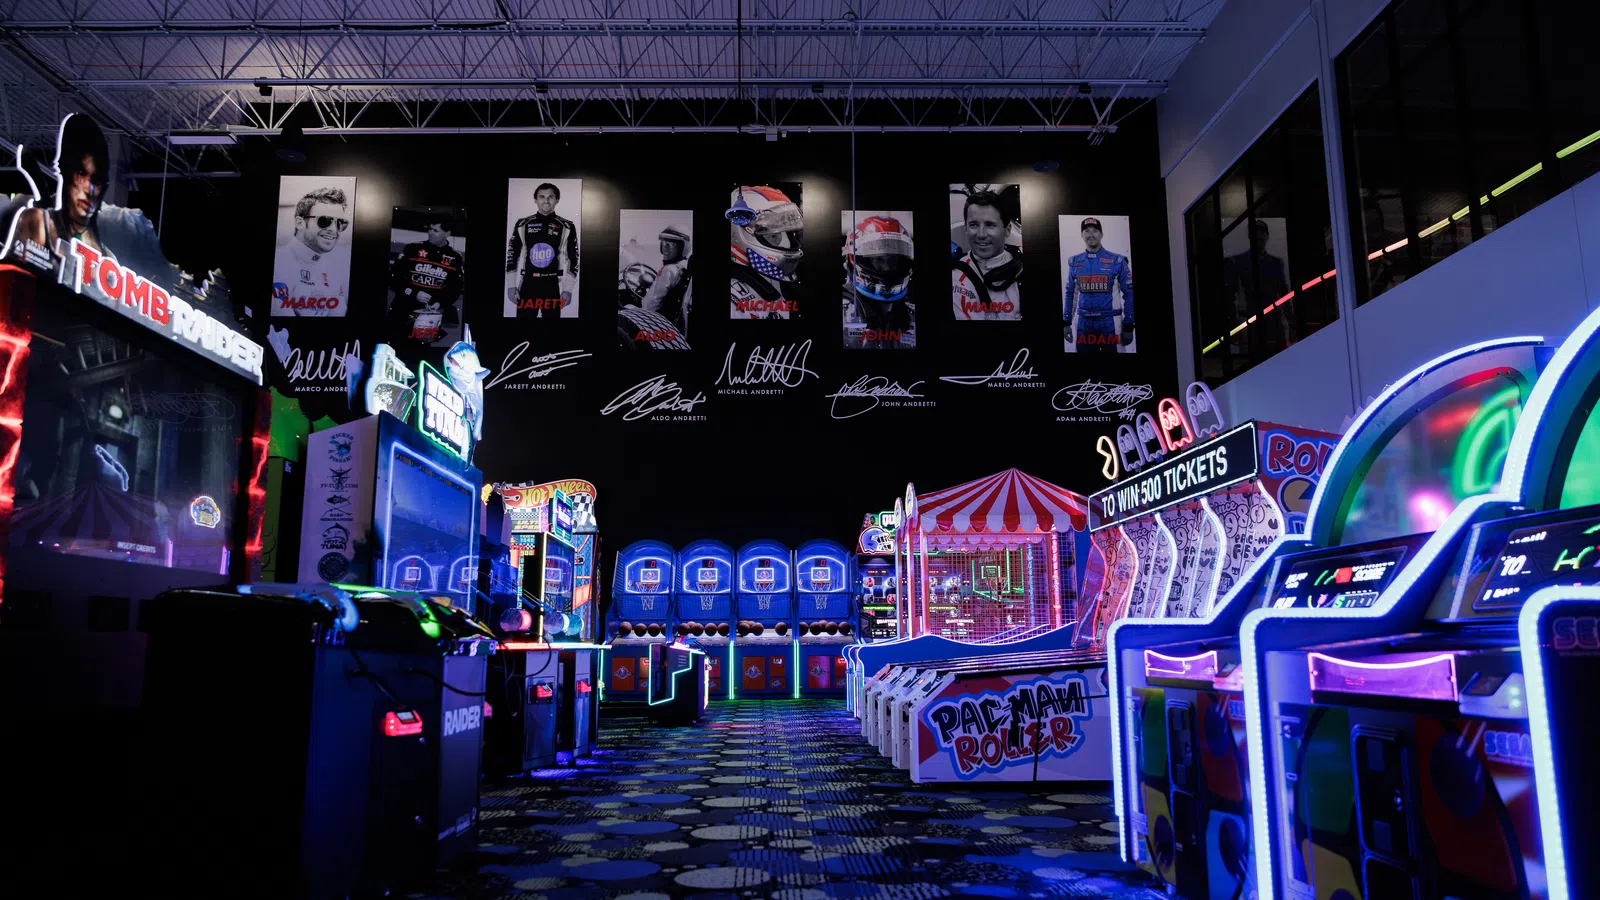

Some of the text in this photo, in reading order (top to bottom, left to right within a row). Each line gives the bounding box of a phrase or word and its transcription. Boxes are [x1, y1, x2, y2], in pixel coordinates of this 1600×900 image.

[415, 263, 448, 278] Gillette
[71, 238, 171, 327] TOMB
[168, 295, 264, 377] RAIDER
[281, 297, 339, 310] MARCO
[517, 298, 567, 310] JARETT
[735, 299, 799, 312] MICHAEL
[964, 301, 1015, 313] MARIO
[408, 327, 440, 339] JEFF
[634, 329, 676, 341] ALDO
[858, 329, 900, 341] JOHN
[1077, 333, 1121, 345] ADAM
[426, 394, 468, 447] TUNA
[1102, 494, 1115, 518] TO
[1141, 475, 1162, 505] 500
[1164, 446, 1228, 495] TICKETS
[519, 488, 549, 508] HOT
[117, 541, 156, 553] INSERT CREDITS
[931, 680, 1087, 745] PAC-MAN
[443, 705, 480, 736] RAIDER
[954, 716, 1081, 773] ROLLER
